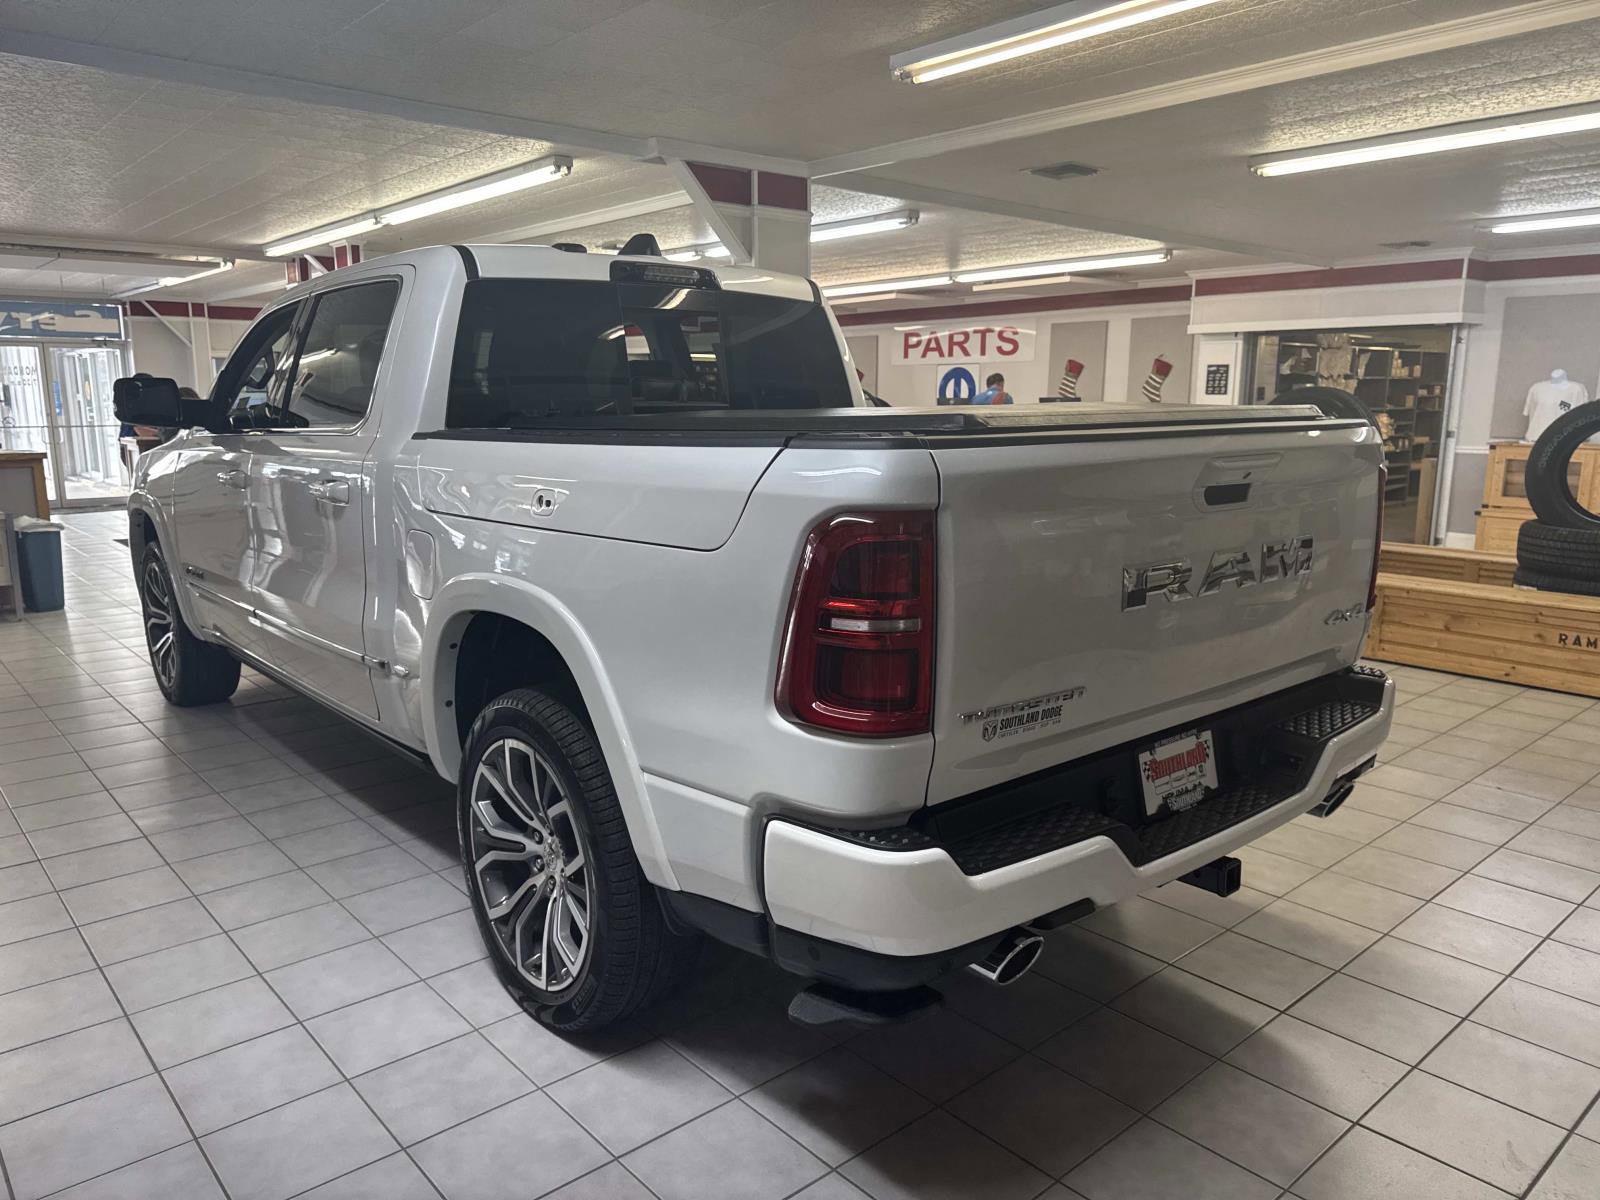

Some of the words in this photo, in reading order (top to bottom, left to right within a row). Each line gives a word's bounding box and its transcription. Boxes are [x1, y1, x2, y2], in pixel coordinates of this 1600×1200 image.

[903, 326, 1020, 359] PARTS
[1122, 535, 1313, 612] RAM
[1558, 632, 1598, 649] RAM
[1000, 710, 1039, 731] SOUTHLAND
[1041, 705, 1063, 720] DODGE
